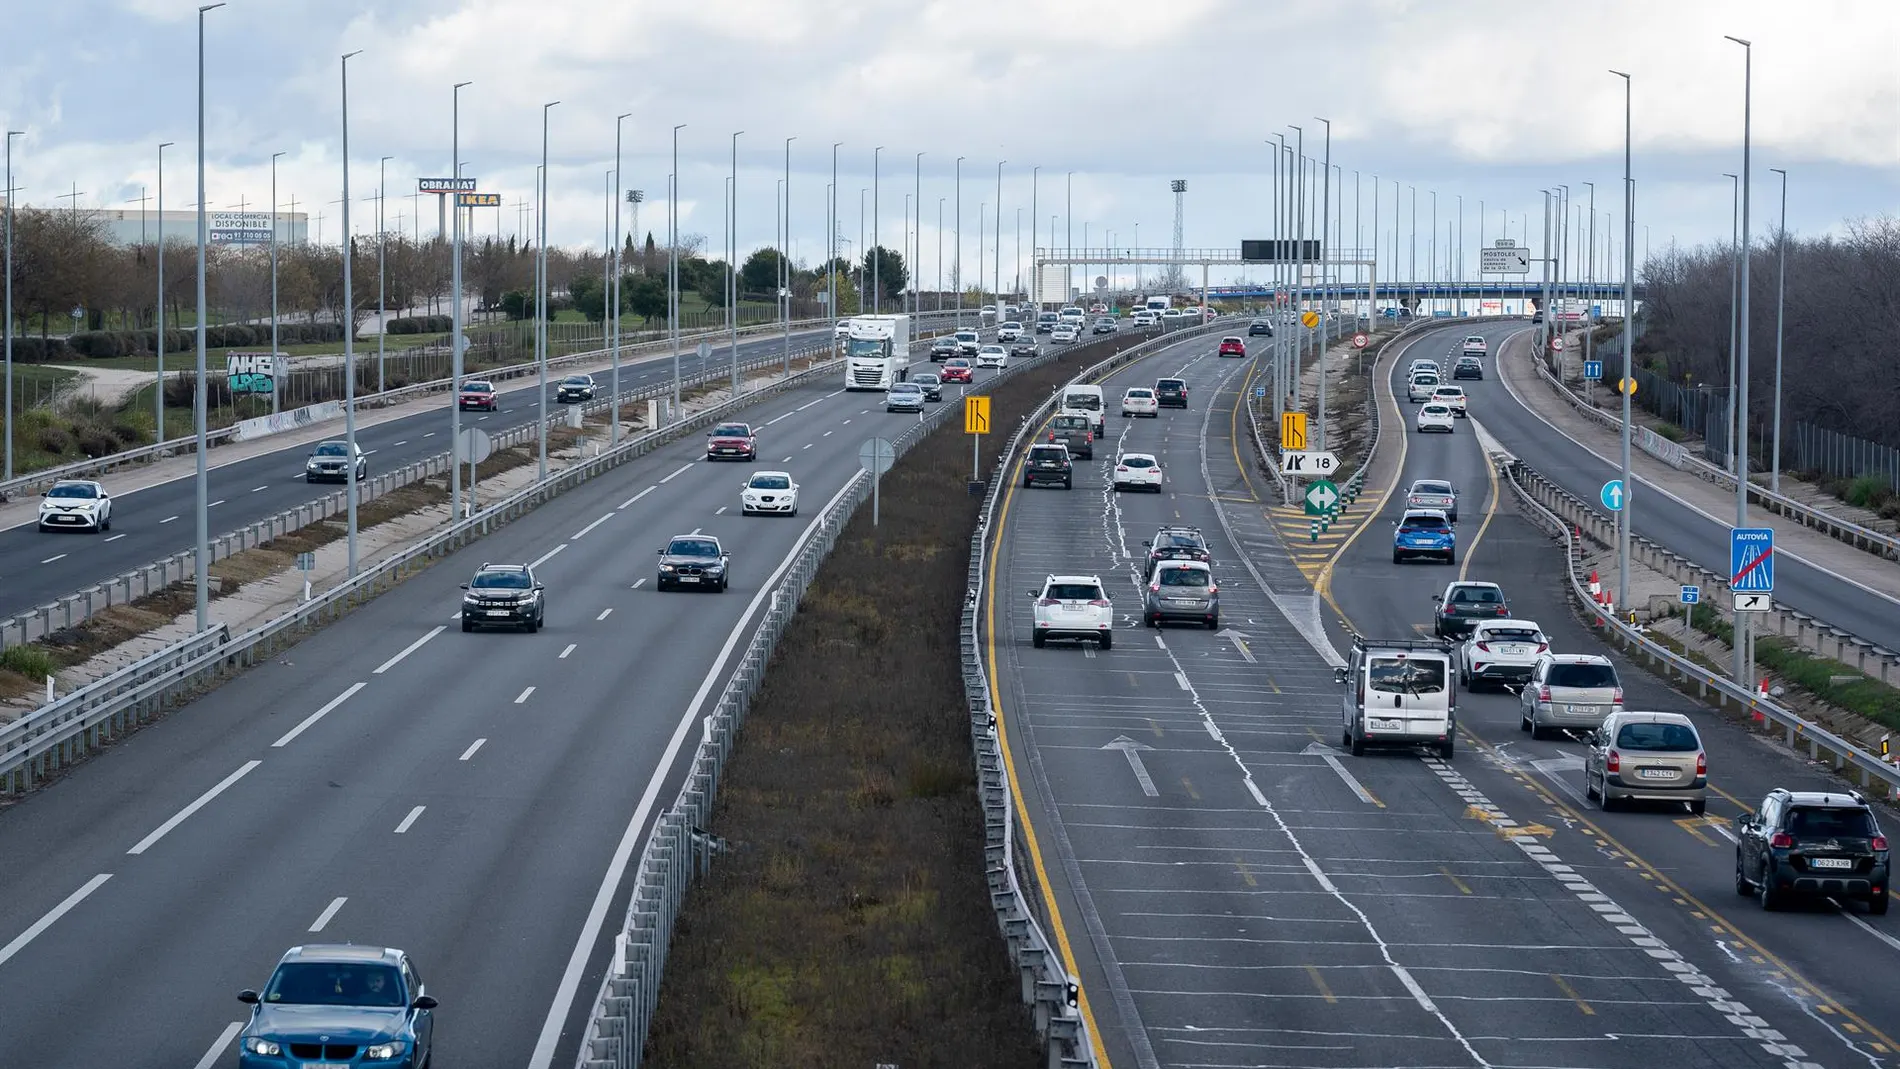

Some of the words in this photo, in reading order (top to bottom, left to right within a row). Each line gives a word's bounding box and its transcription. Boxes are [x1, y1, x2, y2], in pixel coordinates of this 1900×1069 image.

[460, 196, 498, 204] IKEA
[1316, 458, 1330, 468] 18
[1736, 532, 1768, 540] AUTOVÍA
